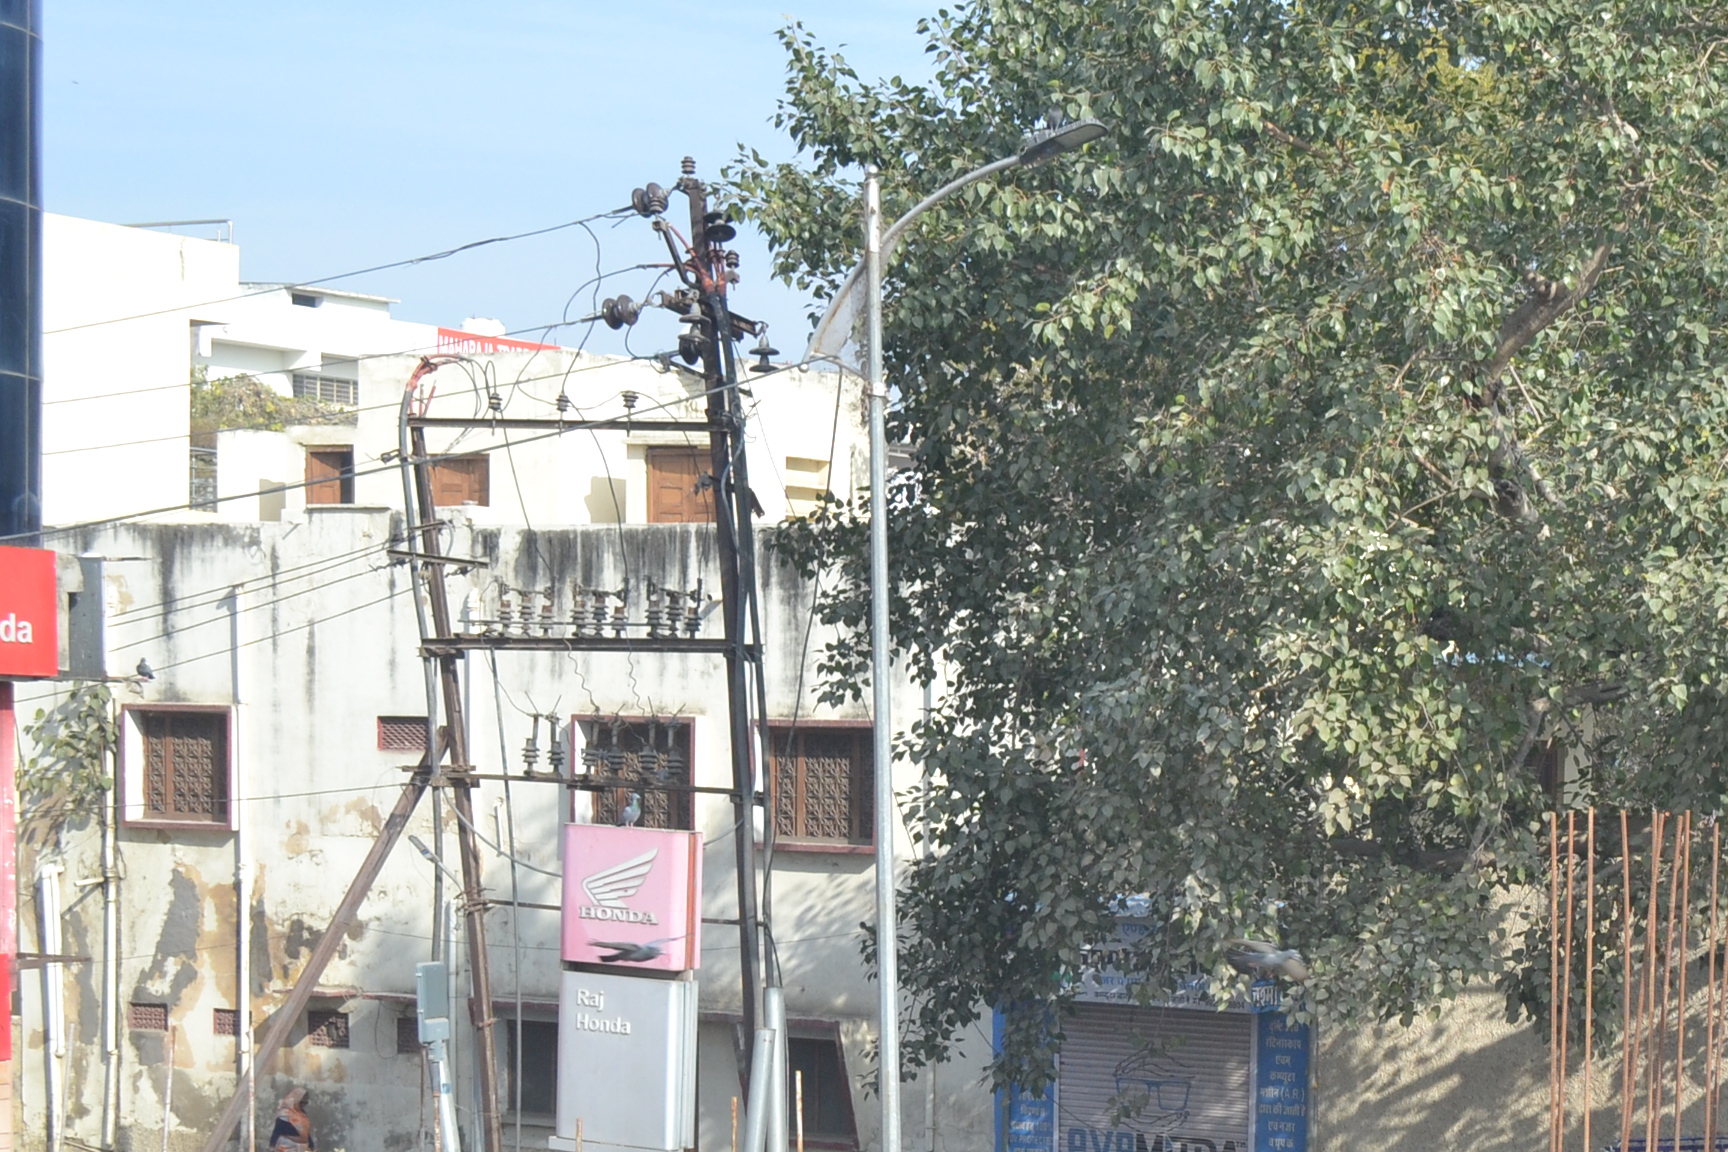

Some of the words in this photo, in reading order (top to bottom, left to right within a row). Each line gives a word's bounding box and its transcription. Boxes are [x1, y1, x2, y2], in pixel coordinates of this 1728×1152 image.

[579, 906, 658, 925] HONDA
[576, 988, 604, 1010] Raj
[576, 1013, 631, 1035] Honda
